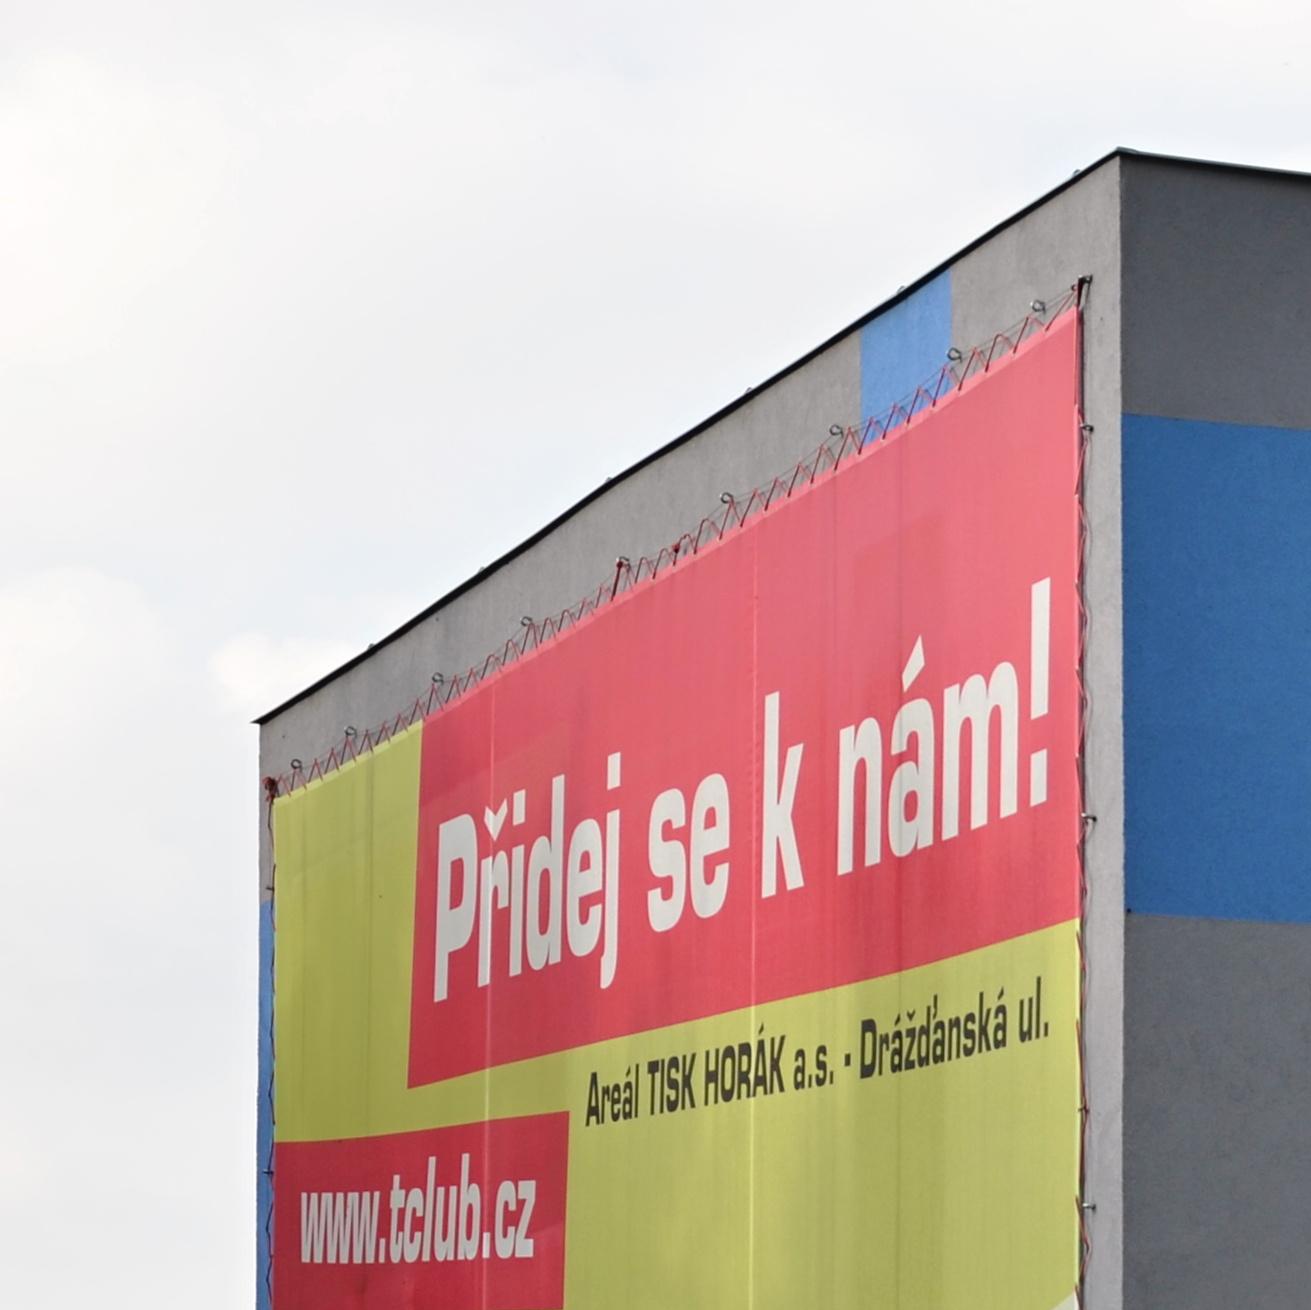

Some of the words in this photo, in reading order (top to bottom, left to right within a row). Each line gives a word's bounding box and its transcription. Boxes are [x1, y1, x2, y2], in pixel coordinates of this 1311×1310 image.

[434, 752, 621, 1002] Přidej
[647, 773, 730, 933] se
[761, 690, 804, 899] k
[837, 576, 1051, 876] nám!
[585, 1063, 639, 1127] Areál
[647, 1052, 696, 1116] TISK
[704, 1021, 786, 1107] HORÁK
[792, 1042, 835, 1091] a.s.
[859, 986, 1008, 1080] Drážďanská
[1018, 976, 1049, 1043] ul.
[301, 1152, 537, 1264] www.tclub.cz
